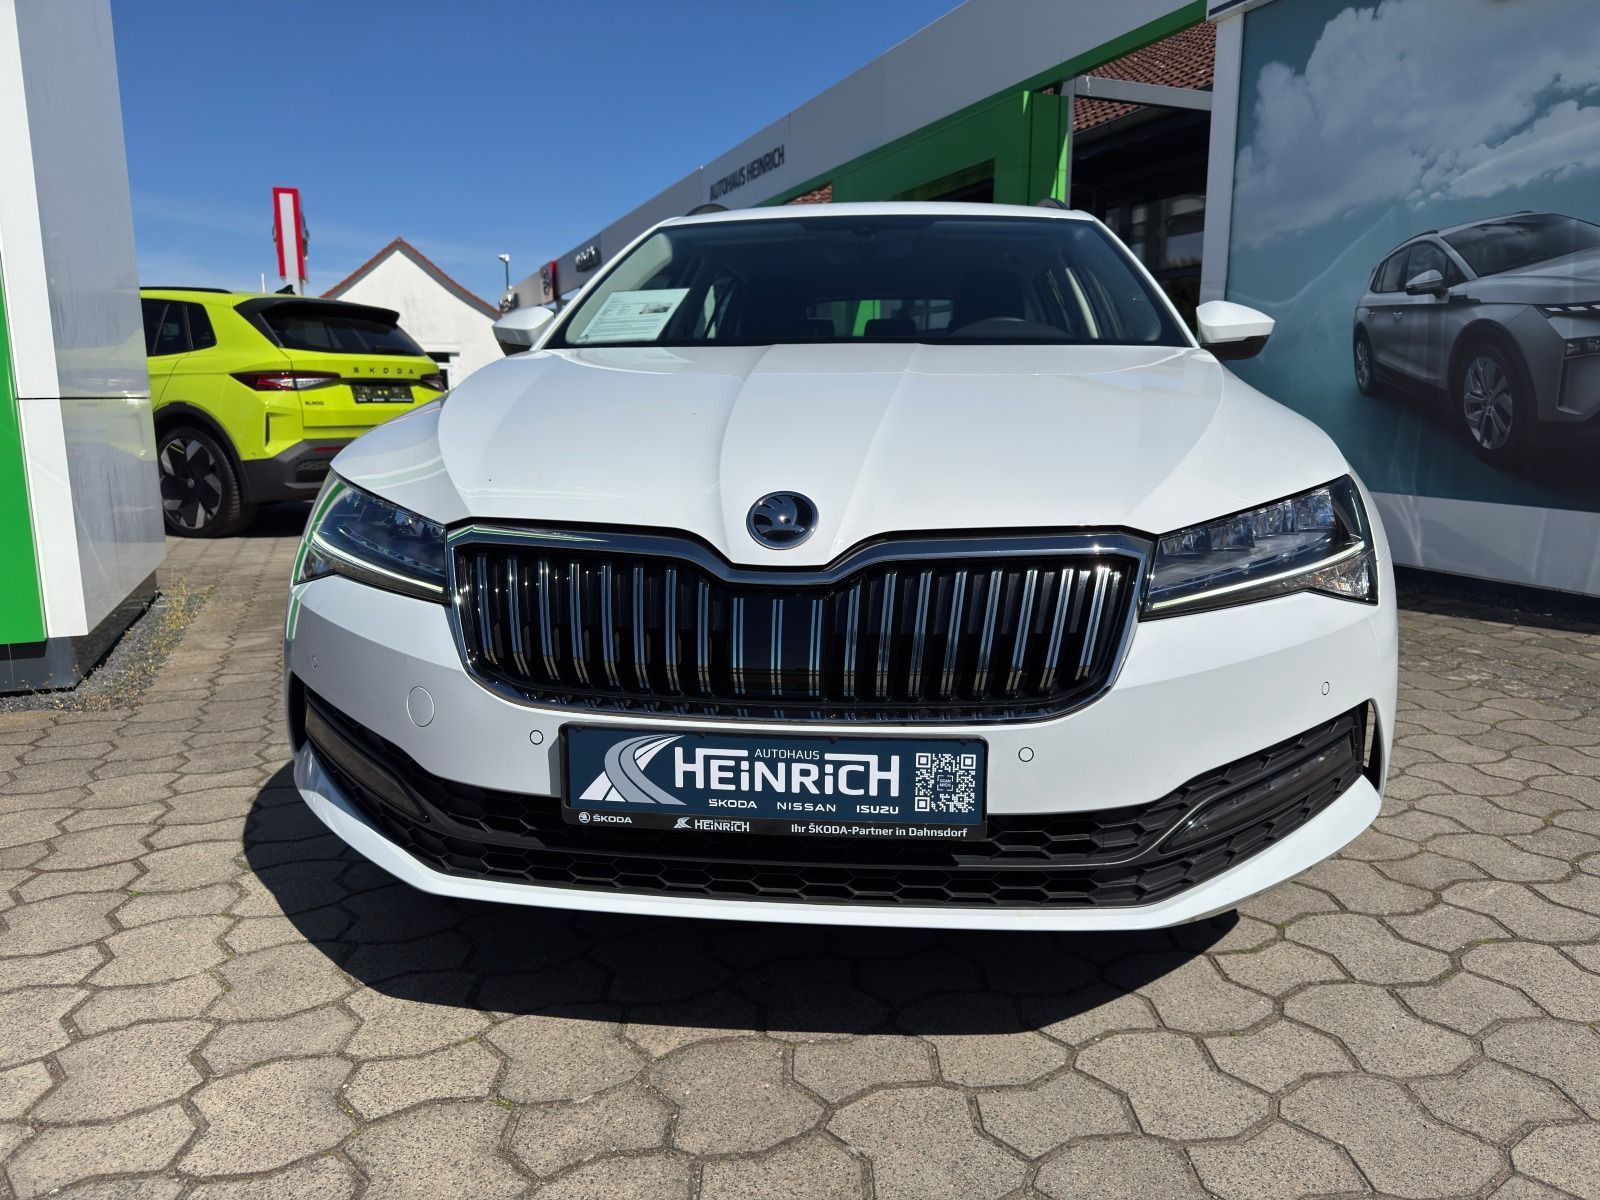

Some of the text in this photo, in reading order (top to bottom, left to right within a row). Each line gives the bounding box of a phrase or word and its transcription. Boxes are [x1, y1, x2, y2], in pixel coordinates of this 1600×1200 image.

[710, 145, 785, 202] AUTOHAUS HEINRICH
[754, 748, 820, 760] AUTOHAUS
[776, 801, 837, 813] NISSAN
[856, 804, 899, 815] ISUZU
[592, 813, 633, 824] ŠKODA
[791, 822, 968, 838] Ihr ŠKODA-Partner in Dahnsdorf
